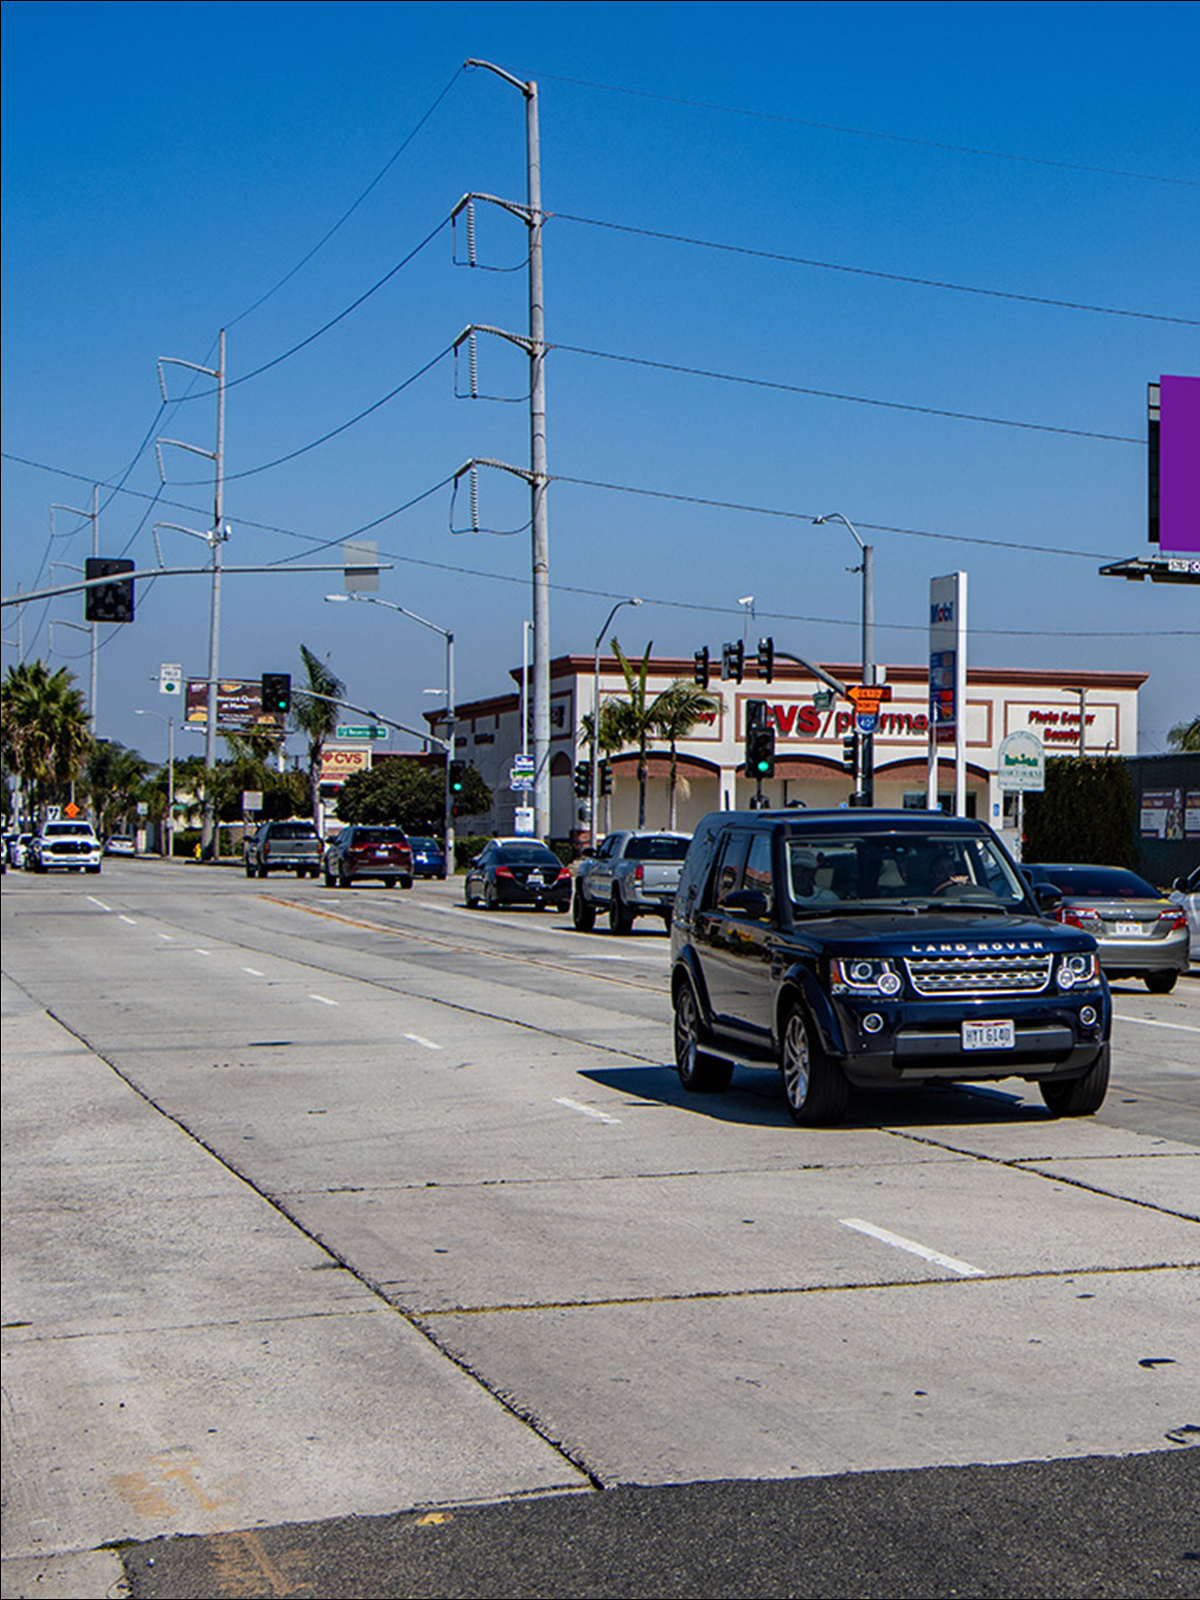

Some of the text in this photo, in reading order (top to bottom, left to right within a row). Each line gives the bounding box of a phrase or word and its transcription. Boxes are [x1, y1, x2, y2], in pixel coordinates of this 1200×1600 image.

[931, 601, 953, 624] Mobil
[1029, 710, 1095, 723] Photo Cener
[1044, 728, 1080, 743] Beauty
[335, 753, 362, 764] CVS
[978, 942, 1043, 951] ROVER
